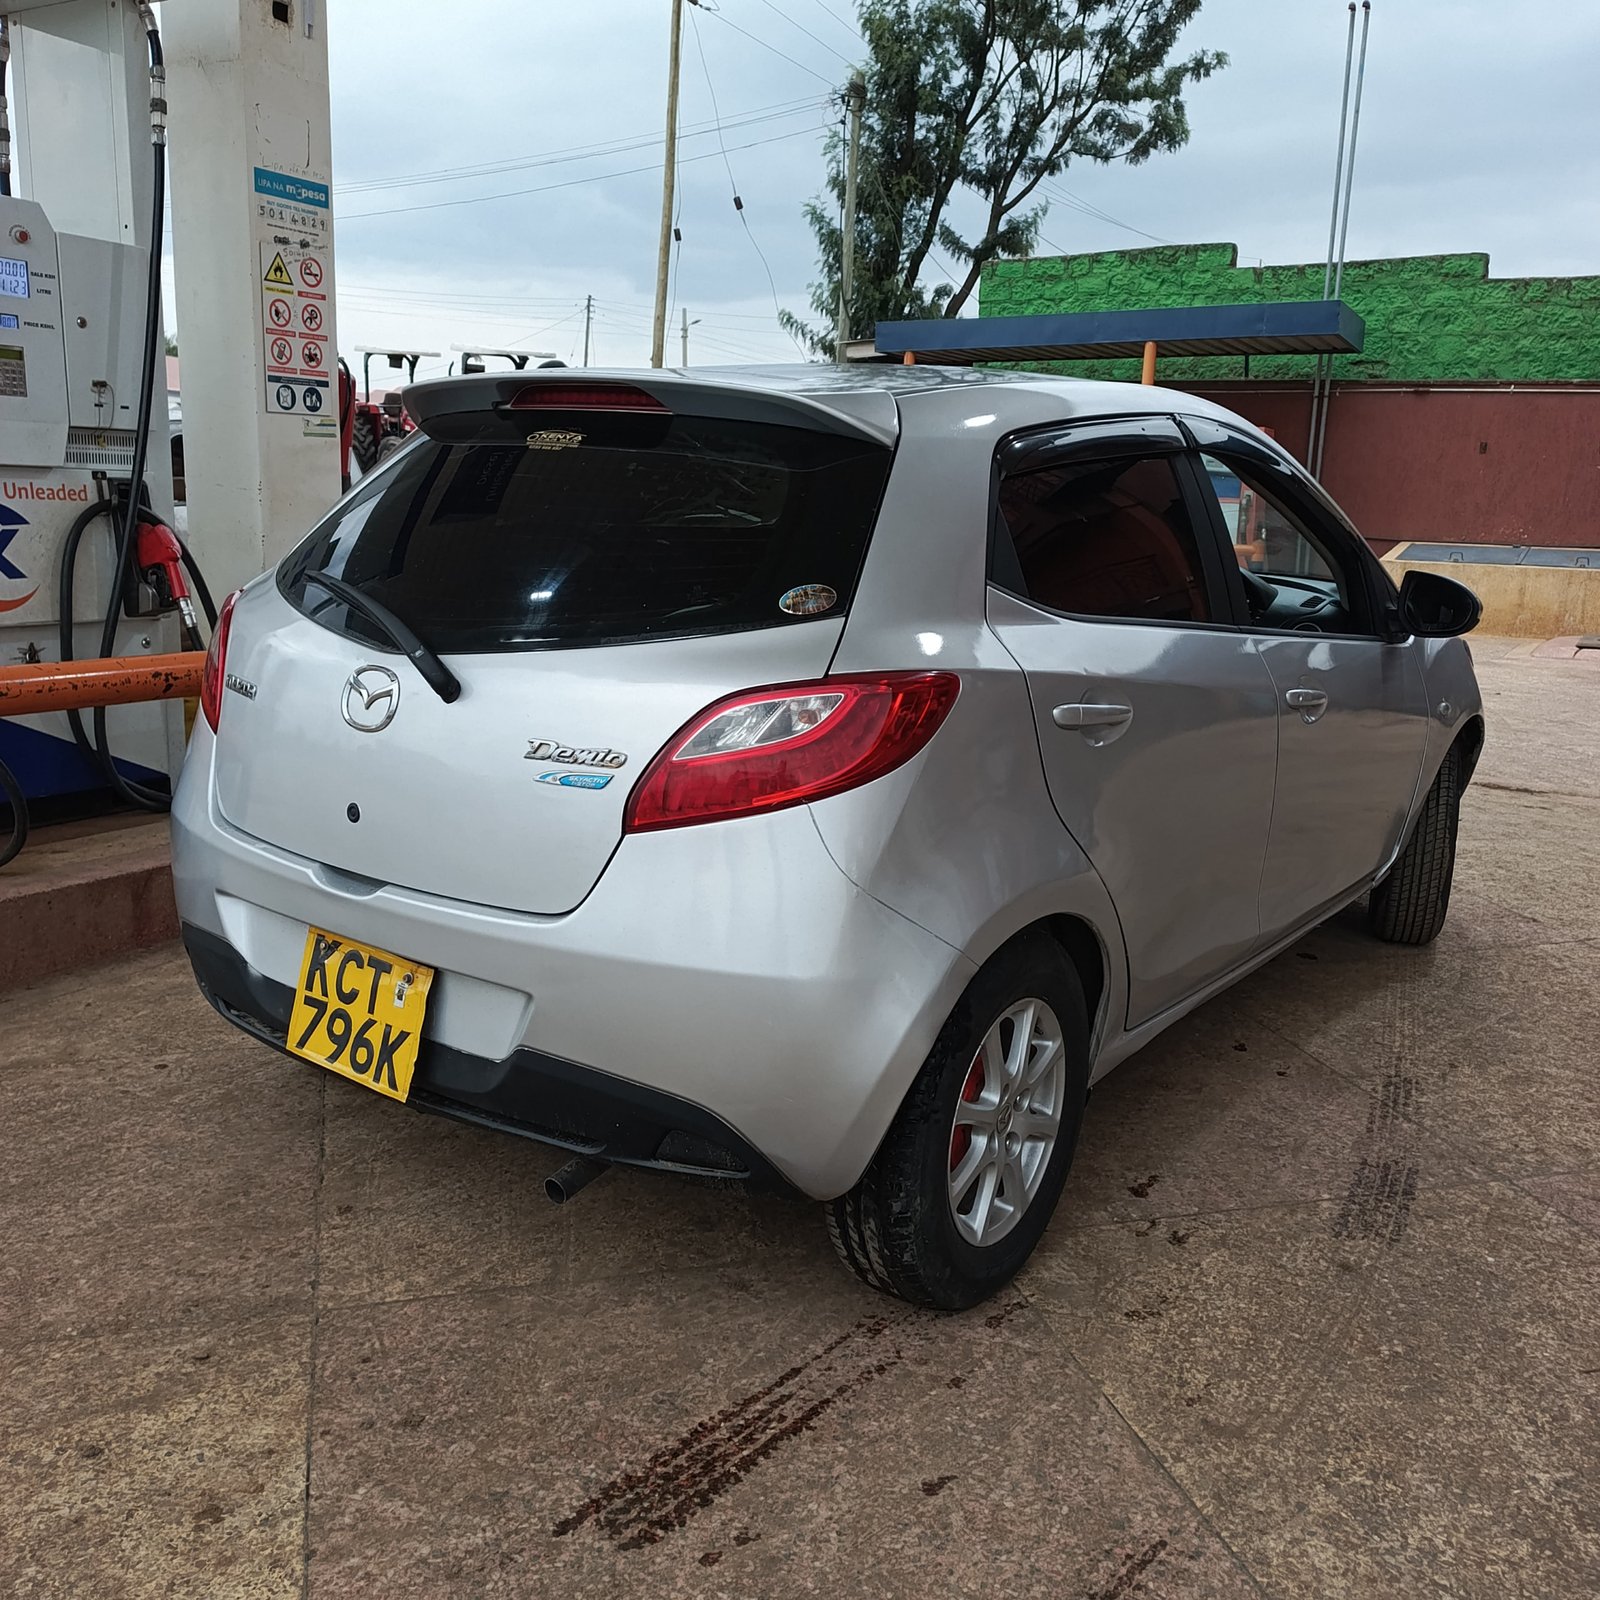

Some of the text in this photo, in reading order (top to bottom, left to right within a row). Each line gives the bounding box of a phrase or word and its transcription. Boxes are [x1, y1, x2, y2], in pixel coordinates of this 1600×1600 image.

[257, 178, 272, 189] LIPA
[273, 182, 284, 192] NA
[3, 482, 88, 502] Unleaded
[523, 738, 628, 769] Demio
[569, 775, 606, 784] SKYACTIV
[304, 933, 393, 1016] KCT
[295, 994, 411, 1093] 796K
